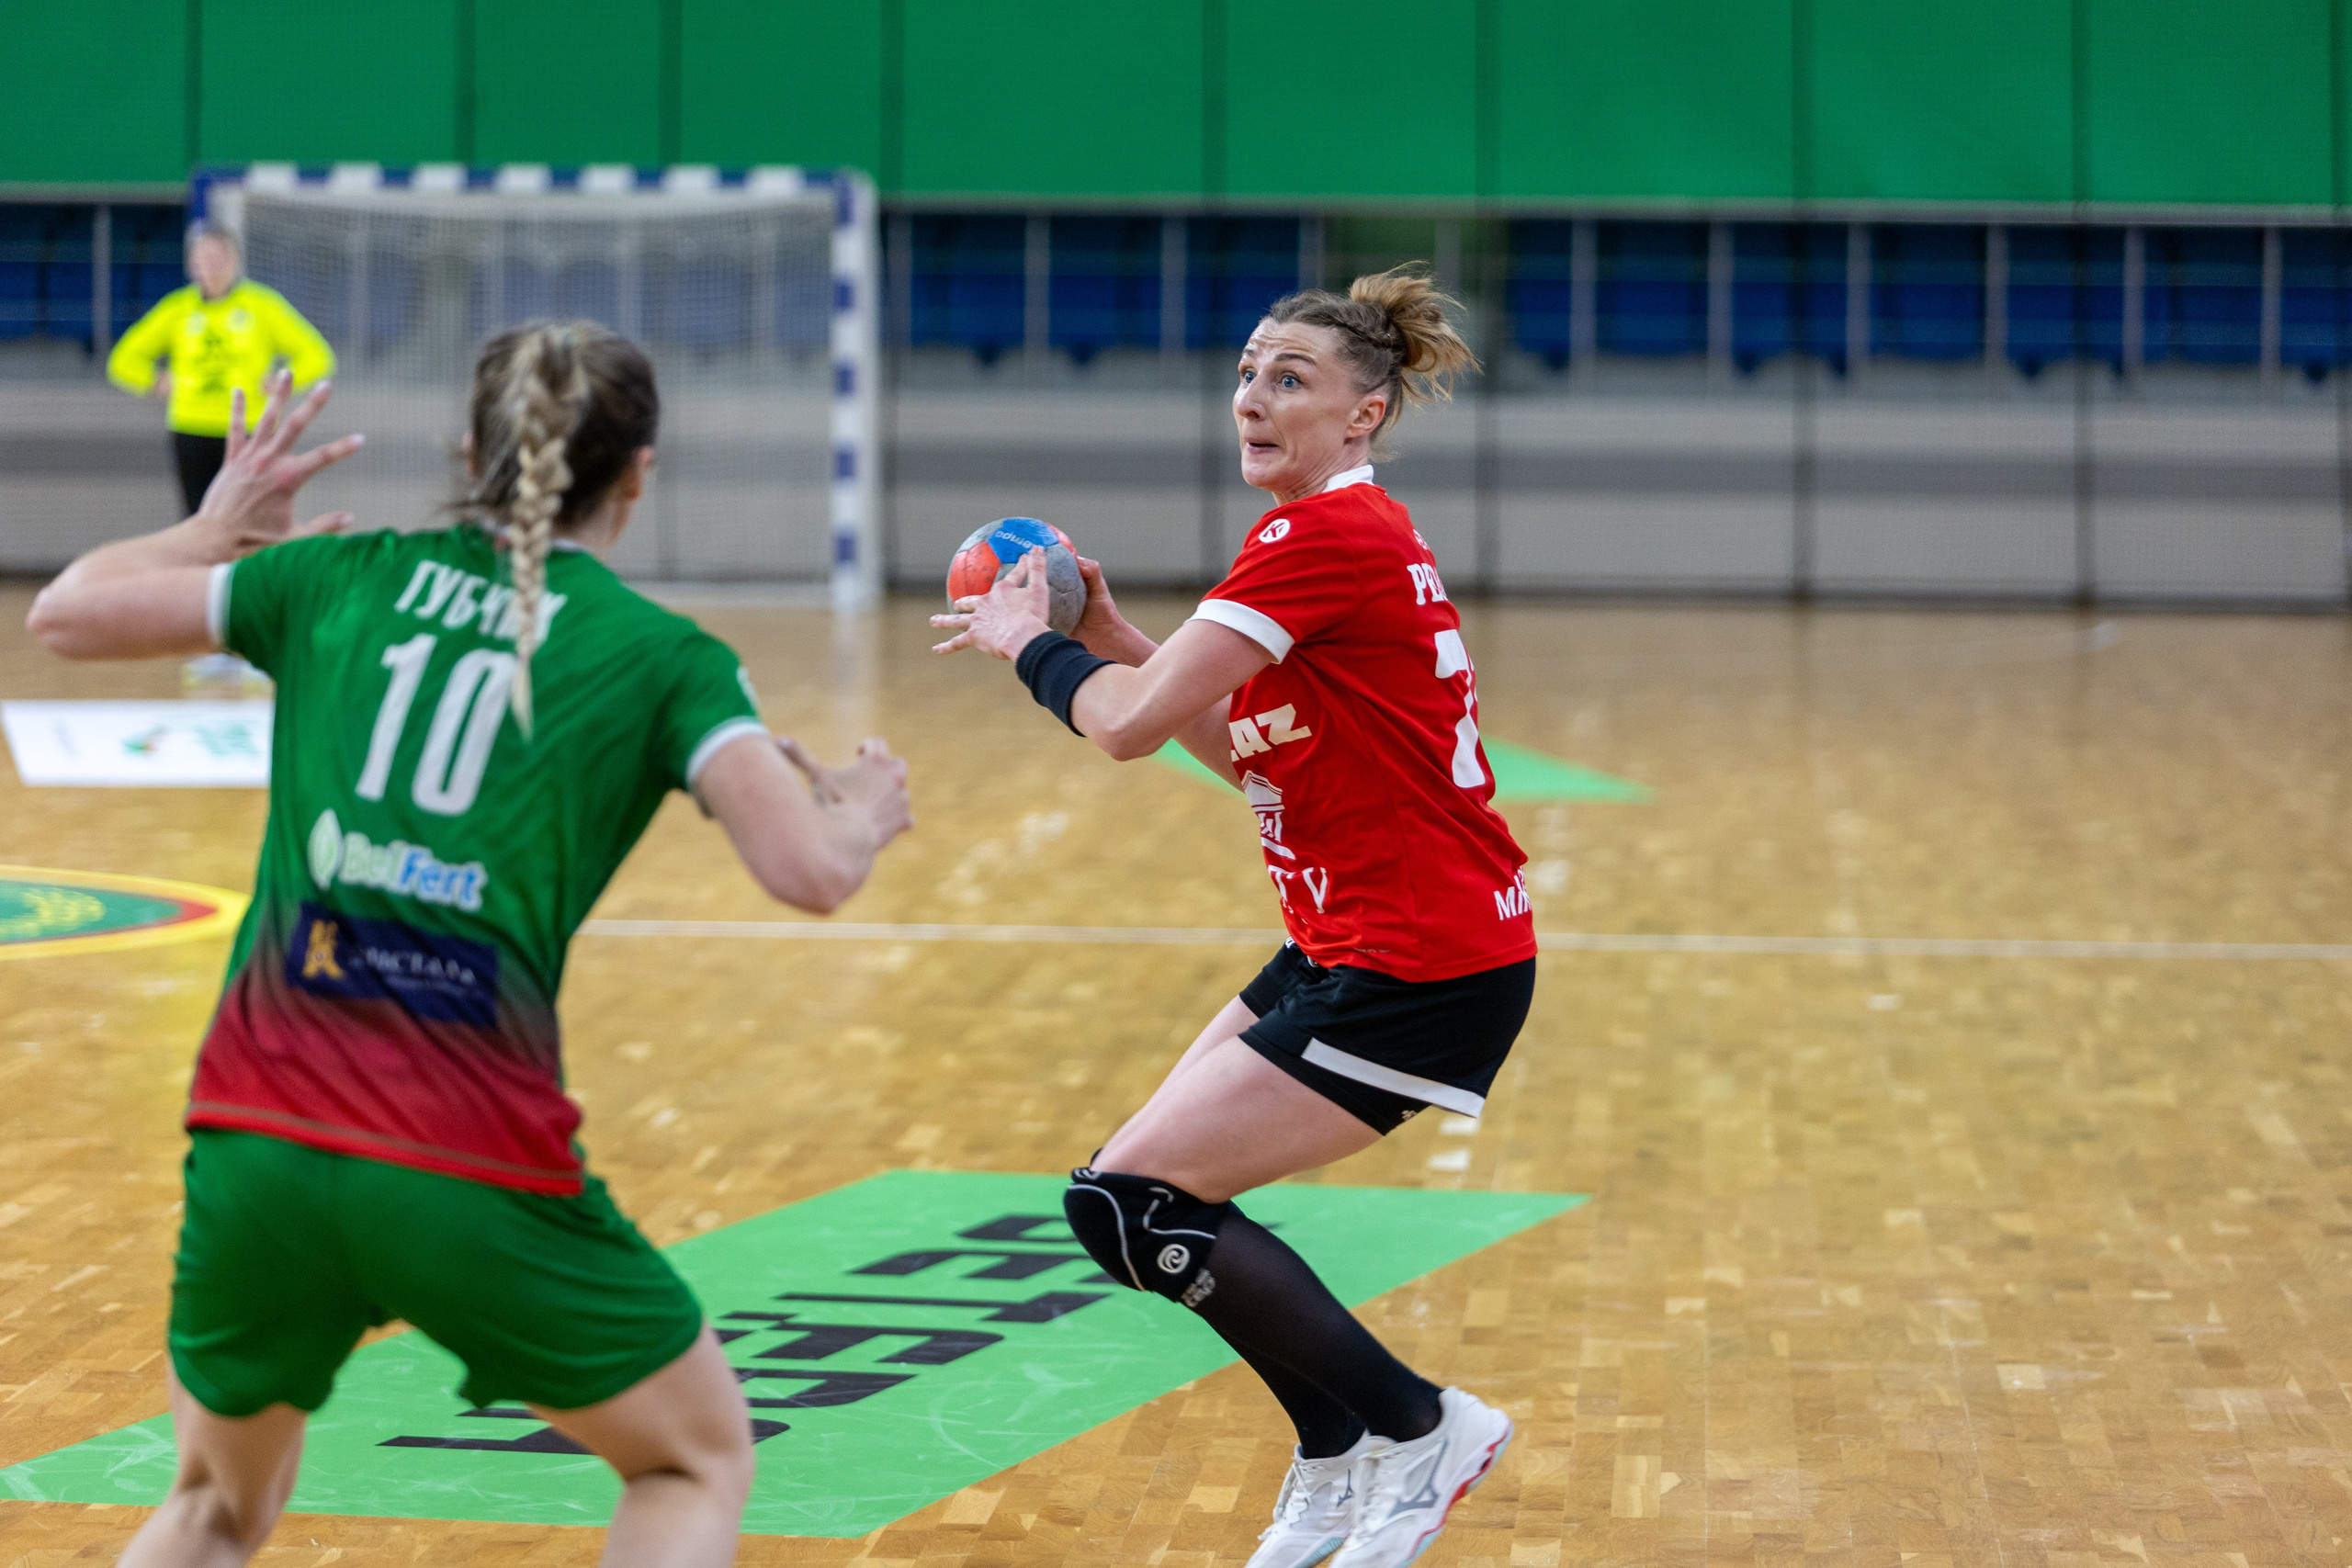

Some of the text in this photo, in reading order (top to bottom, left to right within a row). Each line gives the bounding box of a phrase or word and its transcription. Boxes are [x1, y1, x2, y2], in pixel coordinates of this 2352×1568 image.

[994, 530, 1036, 549] empa
[356, 633, 518, 817] 10
[1228, 703, 1313, 762] AZ
[1435, 629, 1487, 788] 7
